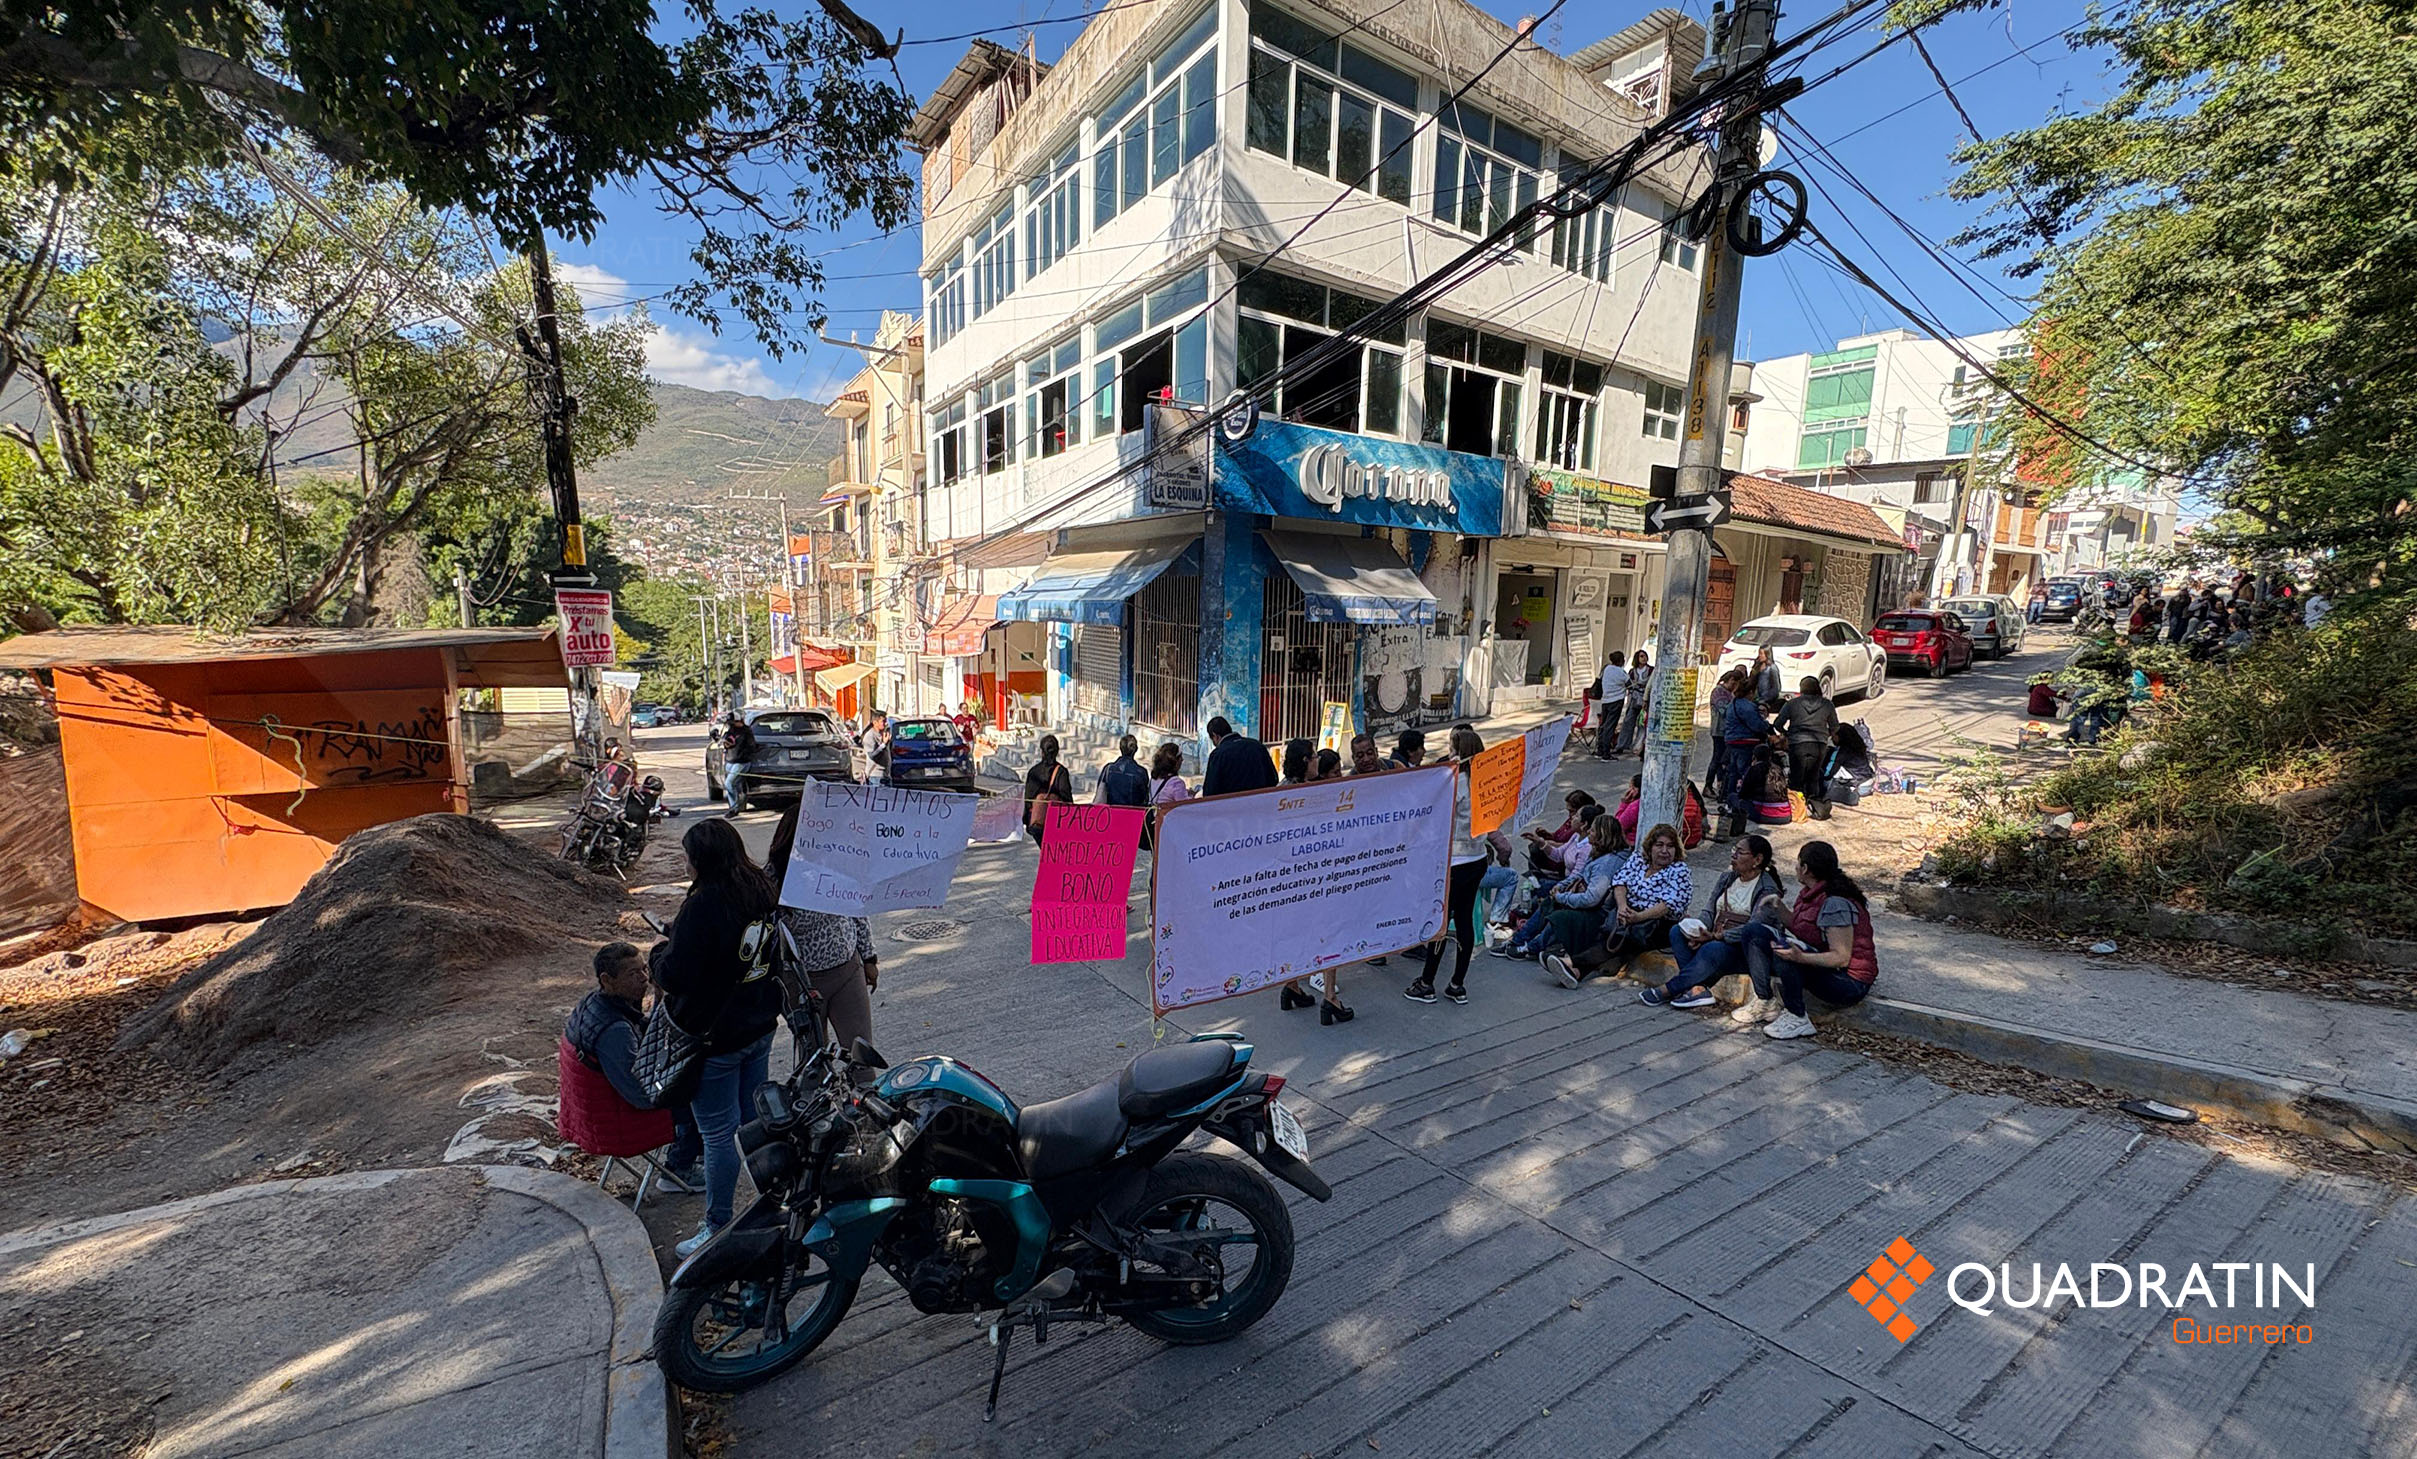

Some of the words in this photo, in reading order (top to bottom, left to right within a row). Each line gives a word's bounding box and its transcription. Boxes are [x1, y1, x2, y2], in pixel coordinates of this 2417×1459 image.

[1299, 442, 1456, 514] Corona
[1154, 485, 1165, 499] LA
[1167, 486, 1203, 502] ESQUINA
[584, 617, 595, 627] tu
[566, 630, 611, 650] auto
[1381, 634, 1409, 648] Extra
[1278, 798, 1305, 811] SNTE
[1339, 788, 1355, 804] 14
[800, 811, 834, 833] Pago
[849, 819, 866, 835] de
[875, 823, 905, 838] BONO
[913, 830, 921, 838] a
[928, 826, 940, 839] la
[1056, 805, 1112, 833] PAGO
[1187, 835, 1263, 864] ¡EDUCACIÓN
[1265, 825, 1318, 845] ESPECIAL
[1320, 821, 1333, 835] SE
[1336, 812, 1391, 832] MANTIENE
[1393, 811, 1407, 822] EN
[1408, 805, 1433, 819] PARO
[1291, 837, 1345, 857] LABORAL!
[1041, 842, 1124, 867] INMEDIATO
[1217, 879, 1241, 891] Ante
[1243, 875, 1252, 884] la
[1254, 870, 1278, 882] falta
[1280, 866, 1292, 877] de
[1293, 861, 1319, 874] fecha
[1320, 857, 1333, 868] de
[1334, 854, 1356, 867] pago
[1357, 849, 1372, 861] del
[1373, 846, 1395, 858] bono
[1396, 843, 1406, 853] de
[1061, 872, 1113, 903] BONO
[1213, 887, 1268, 909] integración
[1270, 876, 1316, 893] educativa
[1318, 875, 1325, 885] y
[1326, 868, 1361, 882] algunas
[1362, 856, 1408, 876] precisiones
[1229, 909, 1241, 920] de
[1243, 904, 1256, 916] las
[1258, 893, 1308, 911] demandas
[1309, 887, 1324, 899] del
[1325, 882, 1353, 898] pliego
[1376, 919, 1397, 930] ENERO
[1046, 933, 1113, 961] EDUCATIVA
